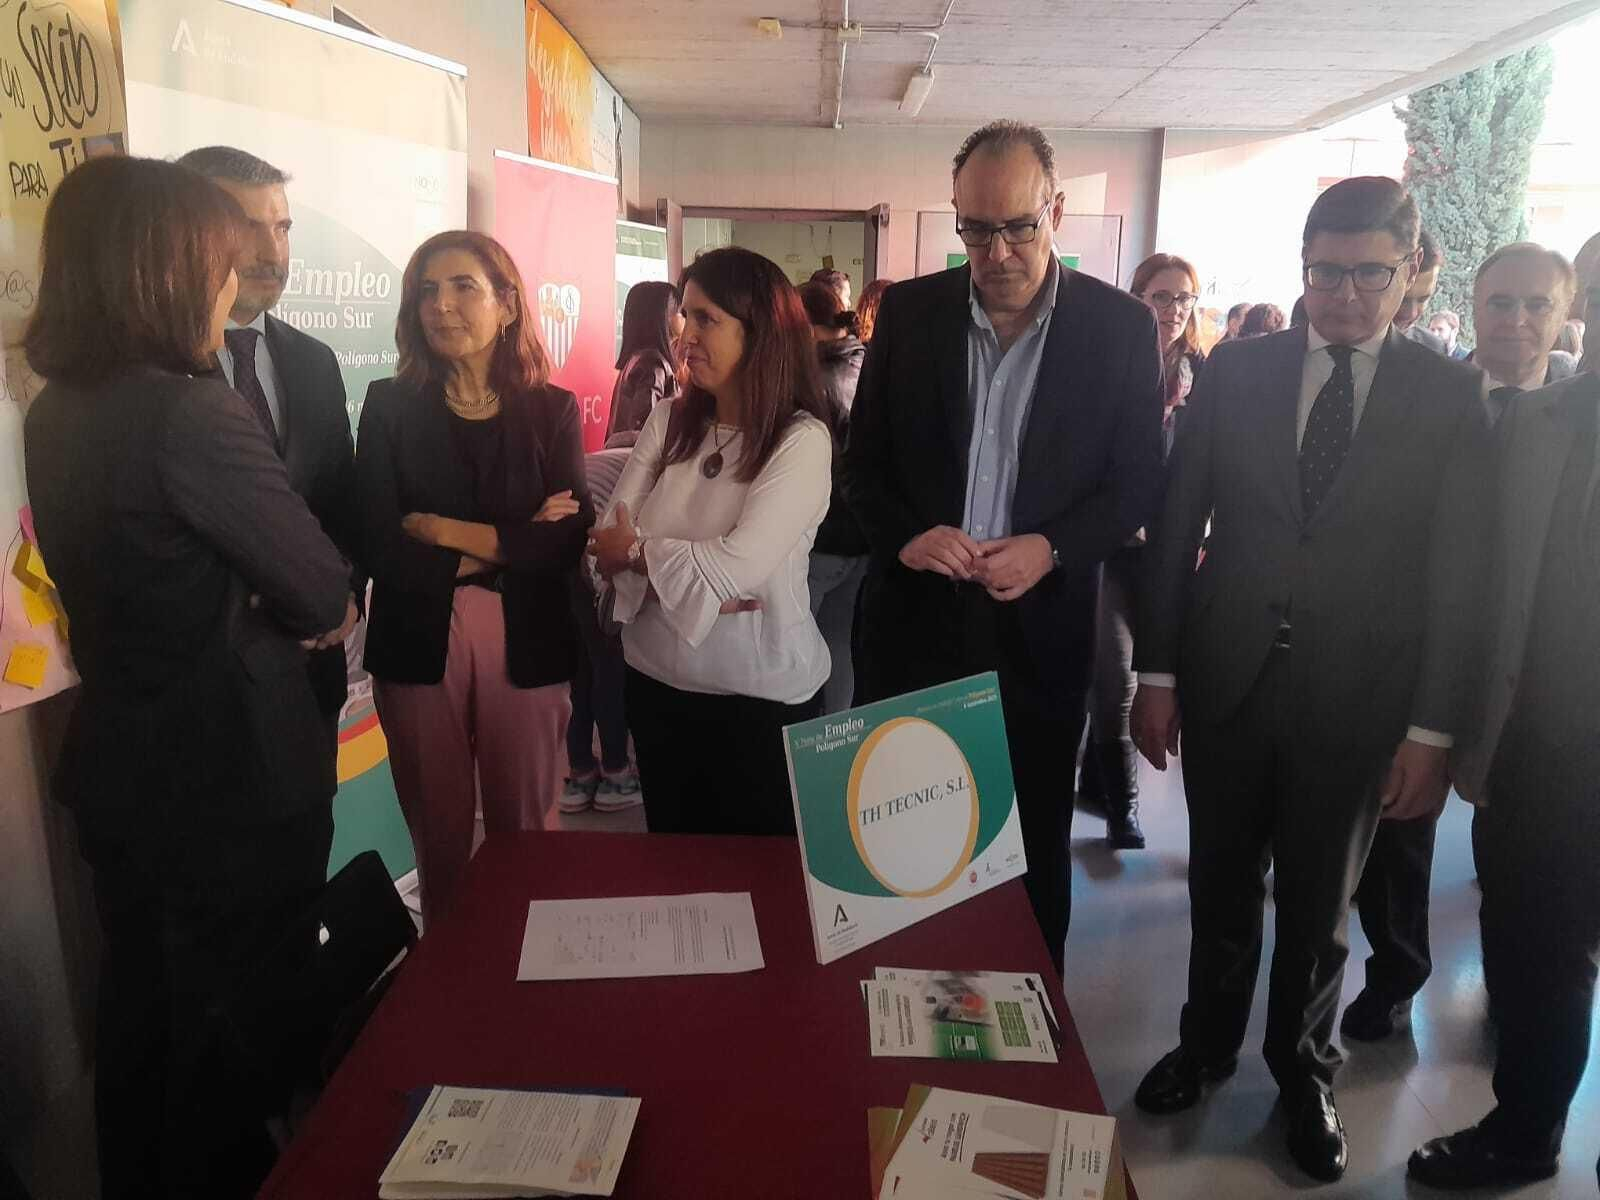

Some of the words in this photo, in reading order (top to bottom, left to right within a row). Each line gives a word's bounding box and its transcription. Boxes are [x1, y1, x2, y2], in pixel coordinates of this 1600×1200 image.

[9, 161, 49, 200] PARA
[286, 257, 392, 305] Empleo
[343, 305, 375, 329] Sur
[824, 717, 864, 738] Empleo
[860, 804, 881, 825] TH
[886, 784, 943, 816] TECNIC,
[946, 776, 970, 795] S.L.
